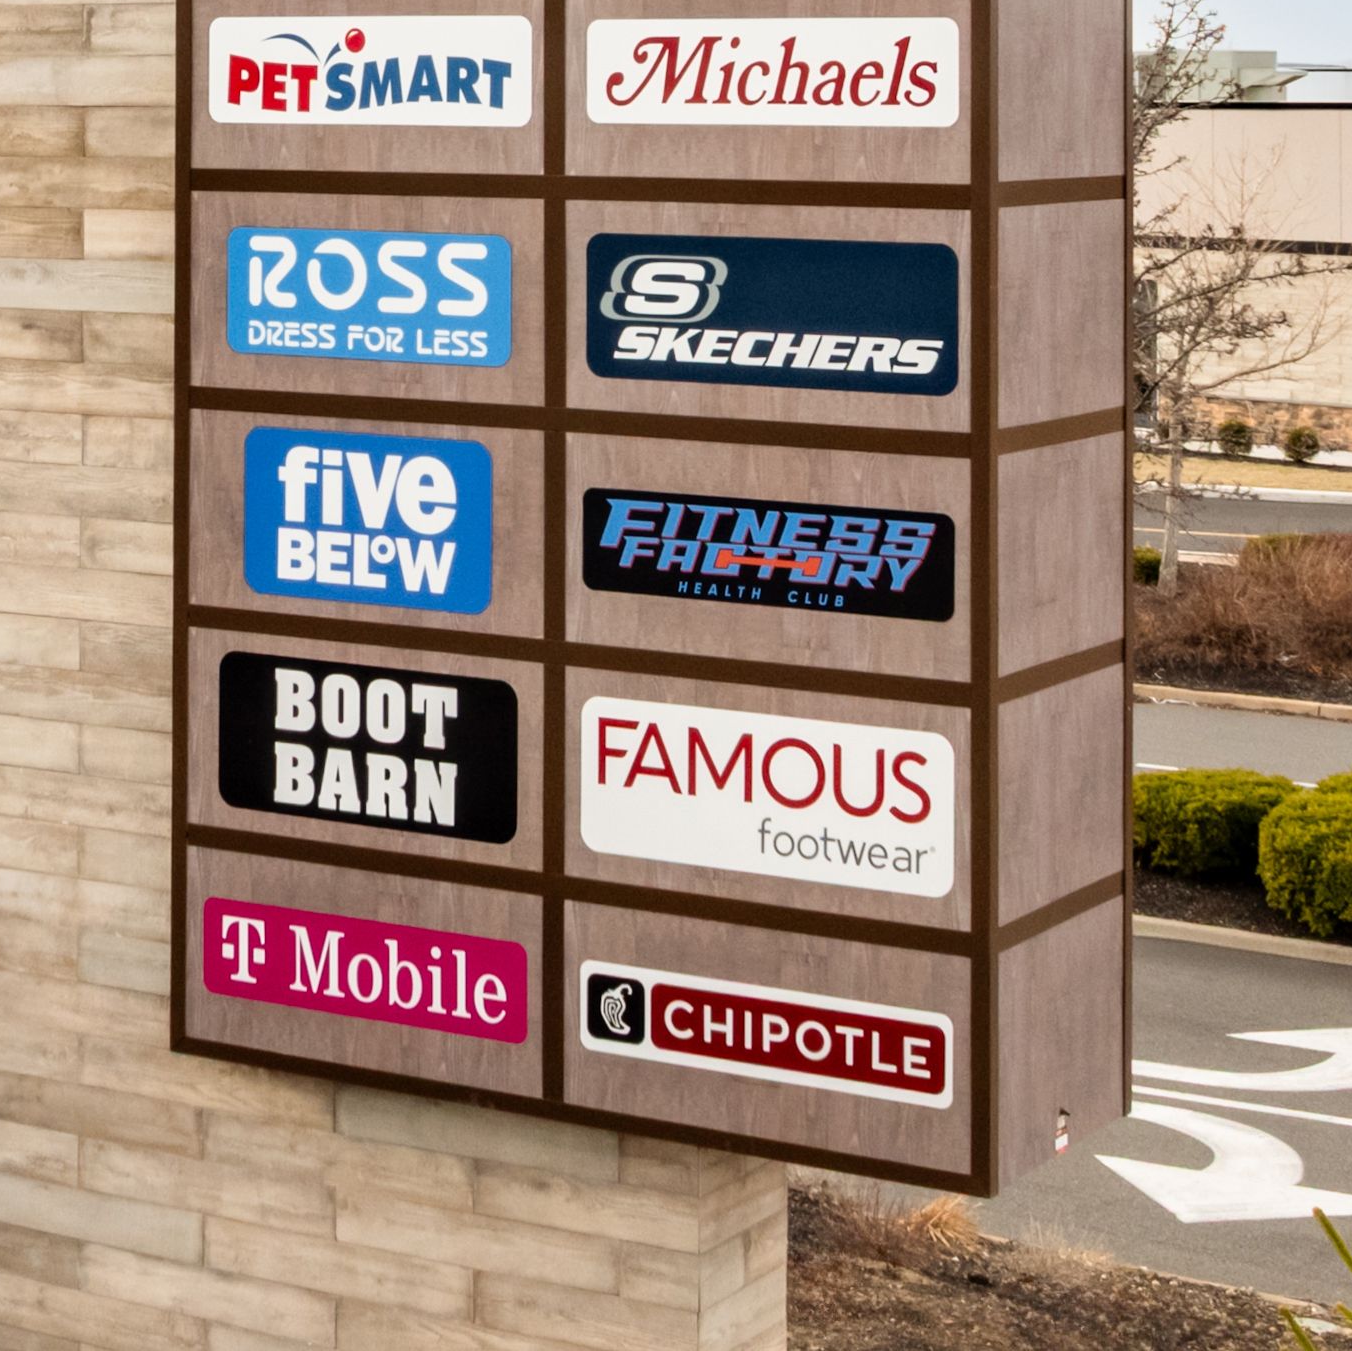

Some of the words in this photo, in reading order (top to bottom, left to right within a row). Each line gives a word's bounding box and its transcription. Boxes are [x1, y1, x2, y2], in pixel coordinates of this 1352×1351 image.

[605, 35, 940, 109] Michaels
[249, 235, 489, 317] ROSS
[248, 319, 337, 349] DRESS
[347, 324, 405, 354] FOR
[416, 328, 489, 358] LESS
[613, 326, 945, 375] SKECHERS
[277, 445, 458, 536] five
[599, 498, 937, 558] FITNESS
[619, 535, 924, 592] FACTORY
[677, 580, 763, 601] HEALTH
[787, 590, 846, 608] CLUB
[273, 667, 459, 750] BOOT
[272, 741, 458, 827] BARN
[595, 716, 933, 825] FAMOUS
[757, 816, 930, 875] footwear
[288, 924, 509, 1025] Mobile
[663, 999, 933, 1080] CHIPOTLE
